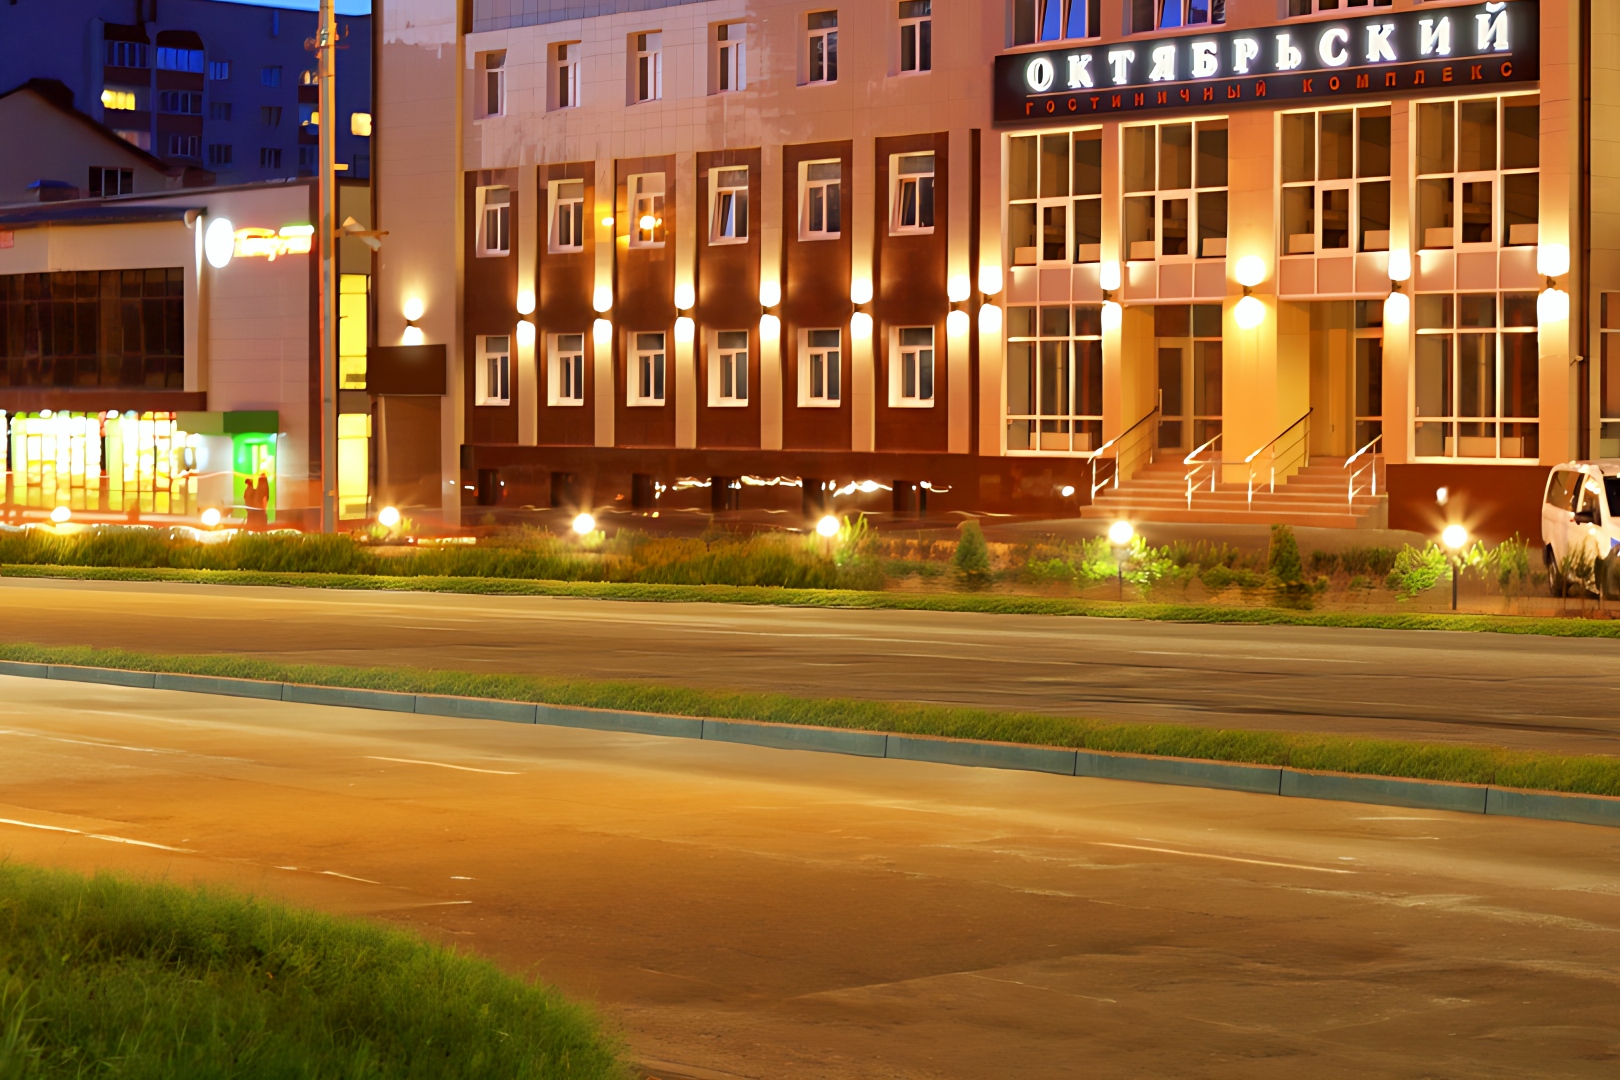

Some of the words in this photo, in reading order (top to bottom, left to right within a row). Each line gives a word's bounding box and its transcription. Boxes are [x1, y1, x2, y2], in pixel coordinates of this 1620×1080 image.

[1026, 1, 1509, 92] ОКТЯБРЬСКИЙ
[1025, 79, 1267, 116] ГОСТИНИЧНЫЙ
[1302, 61, 1513, 93] КОМПЛЕКС
